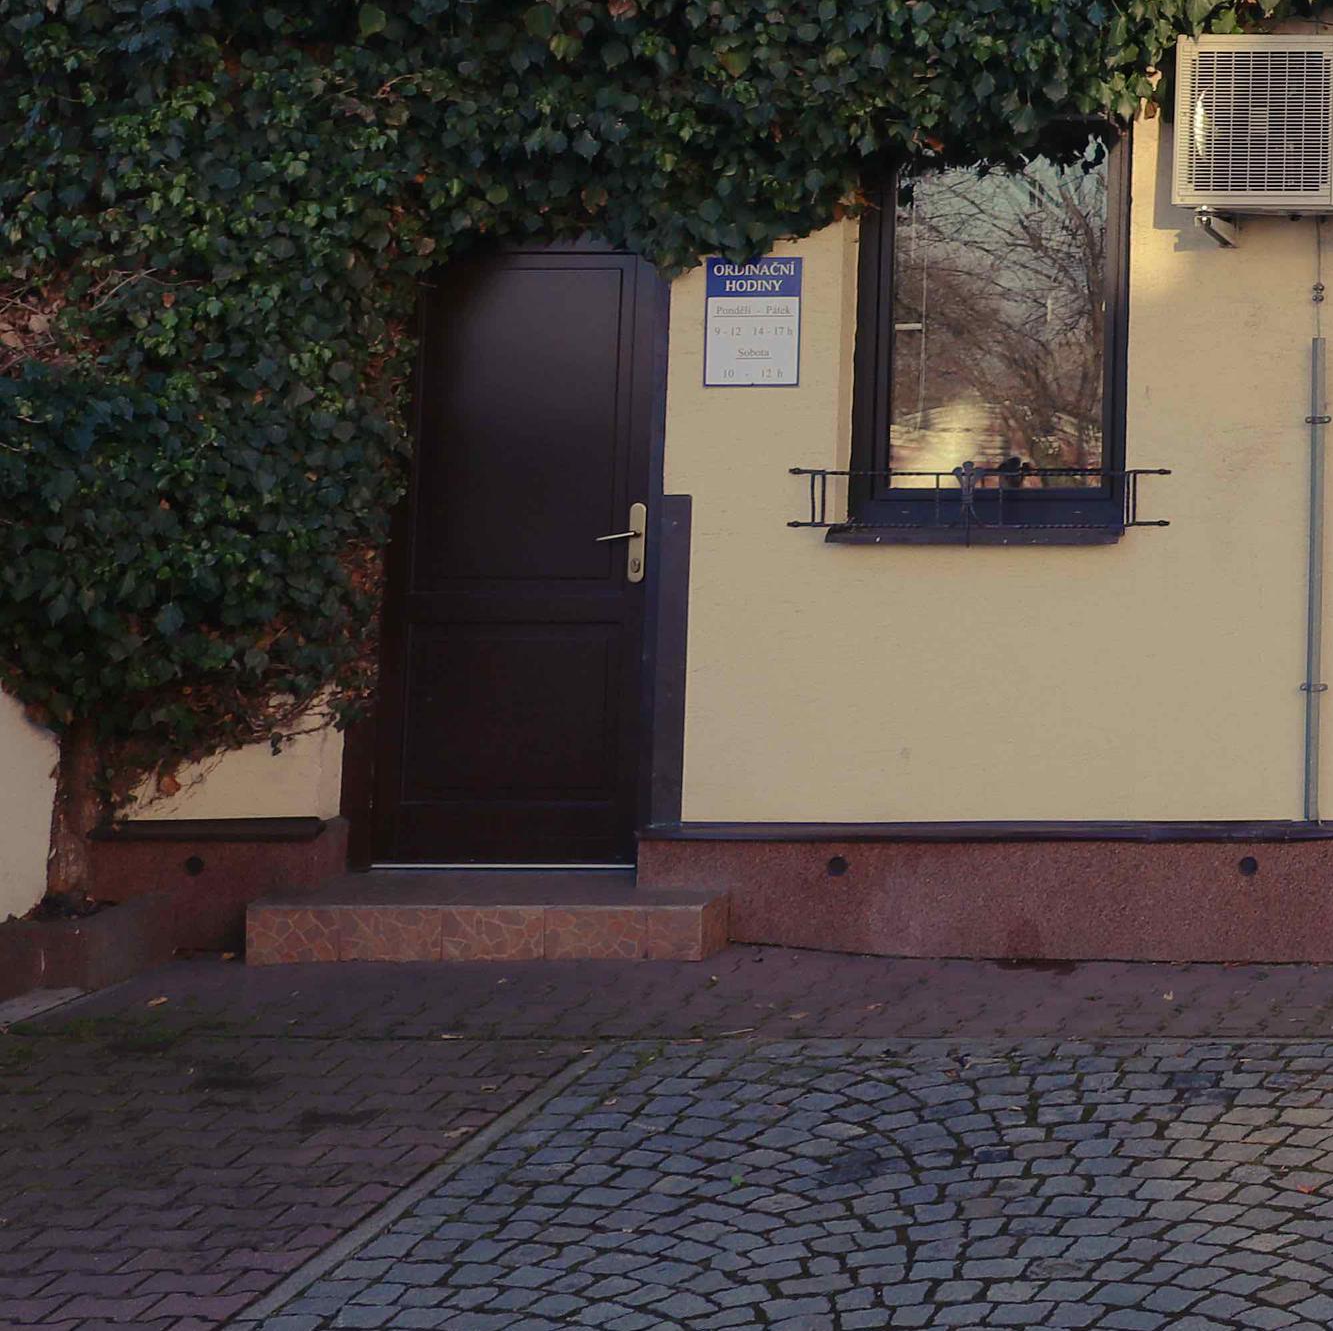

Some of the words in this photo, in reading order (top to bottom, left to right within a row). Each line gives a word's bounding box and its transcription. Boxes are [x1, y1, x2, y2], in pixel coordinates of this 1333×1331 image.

[725, 279, 783, 292] HODINY
[766, 303, 791, 315] Pátek
[714, 326, 721, 335] 9
[731, 326, 742, 336] 12
[753, 326, 764, 335] 14
[774, 326, 784, 335] 17
[787, 326, 793, 335] h
[737, 348, 770, 357] Sobota
[723, 369, 735, 378] 10
[761, 369, 772, 378] 12
[777, 369, 783, 378] h
